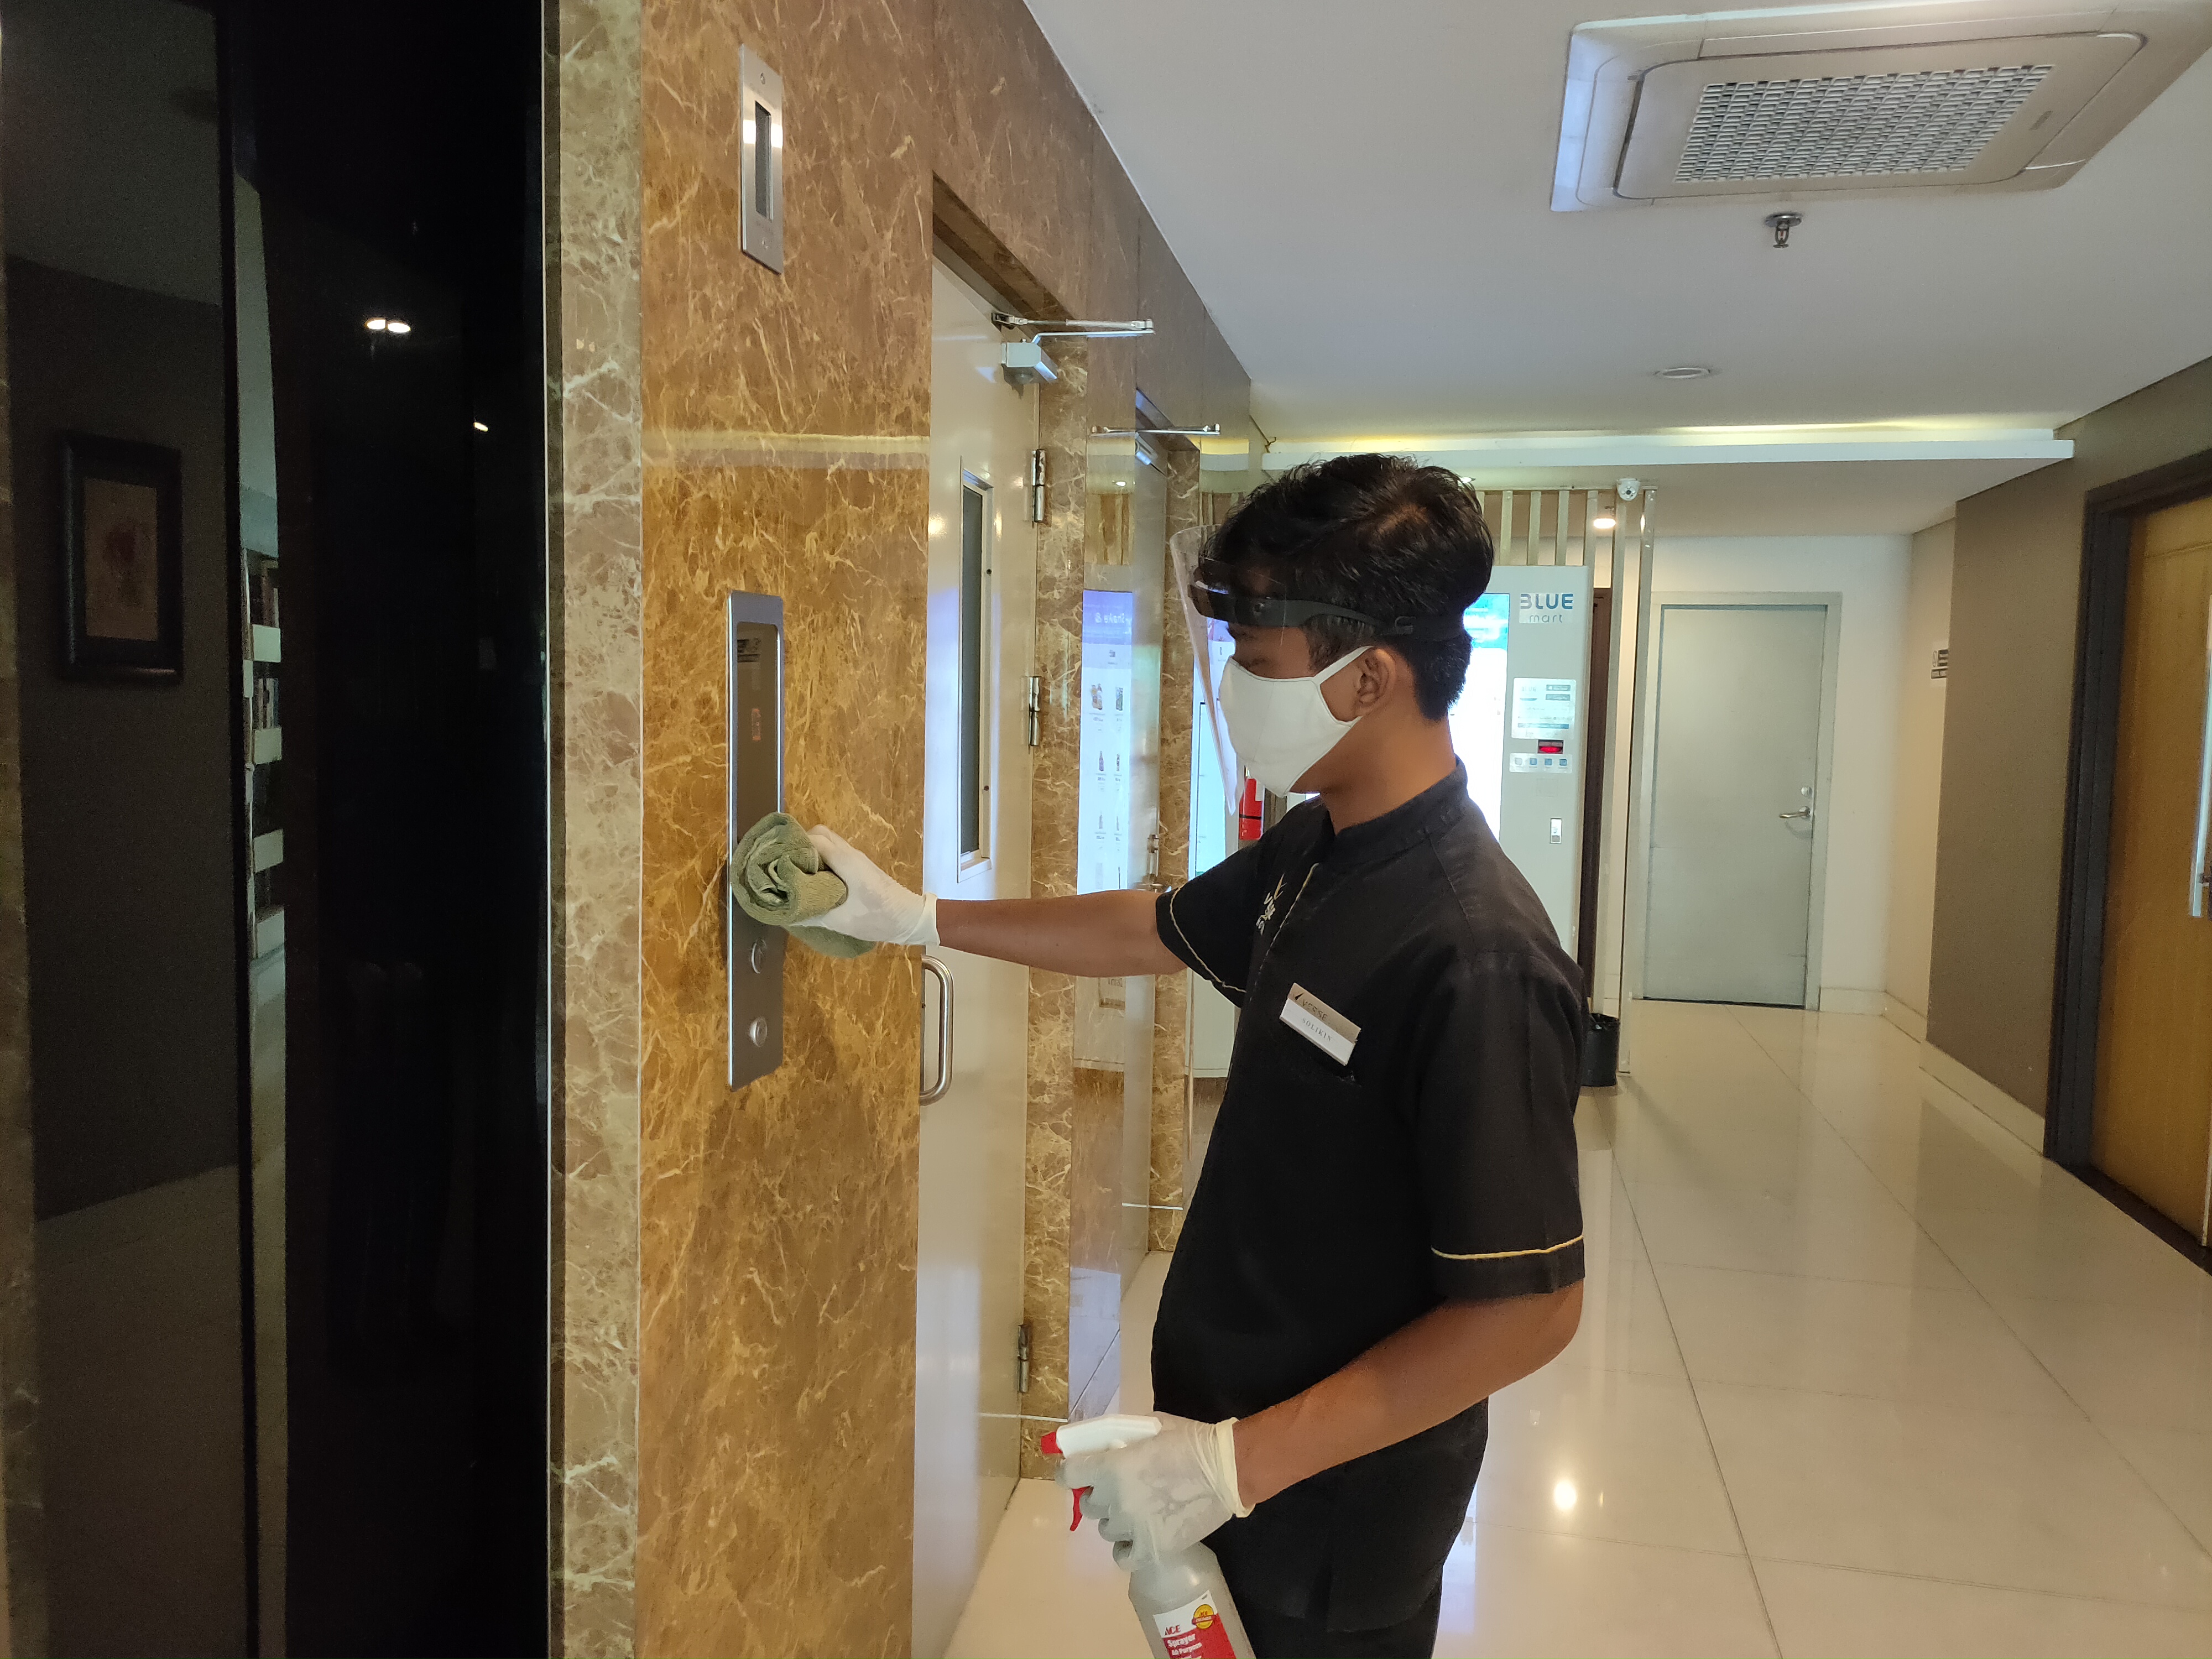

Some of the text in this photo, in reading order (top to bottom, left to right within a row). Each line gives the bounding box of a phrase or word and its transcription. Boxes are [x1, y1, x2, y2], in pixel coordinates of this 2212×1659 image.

[1520, 593, 1573, 609] BLUE
[1529, 614, 1562, 623] mart
[1302, 1018, 1332, 1041] SOLIKIN
[1164, 1624, 1181, 1636] ACE
[1167, 1633, 1196, 1648] Sprayer
